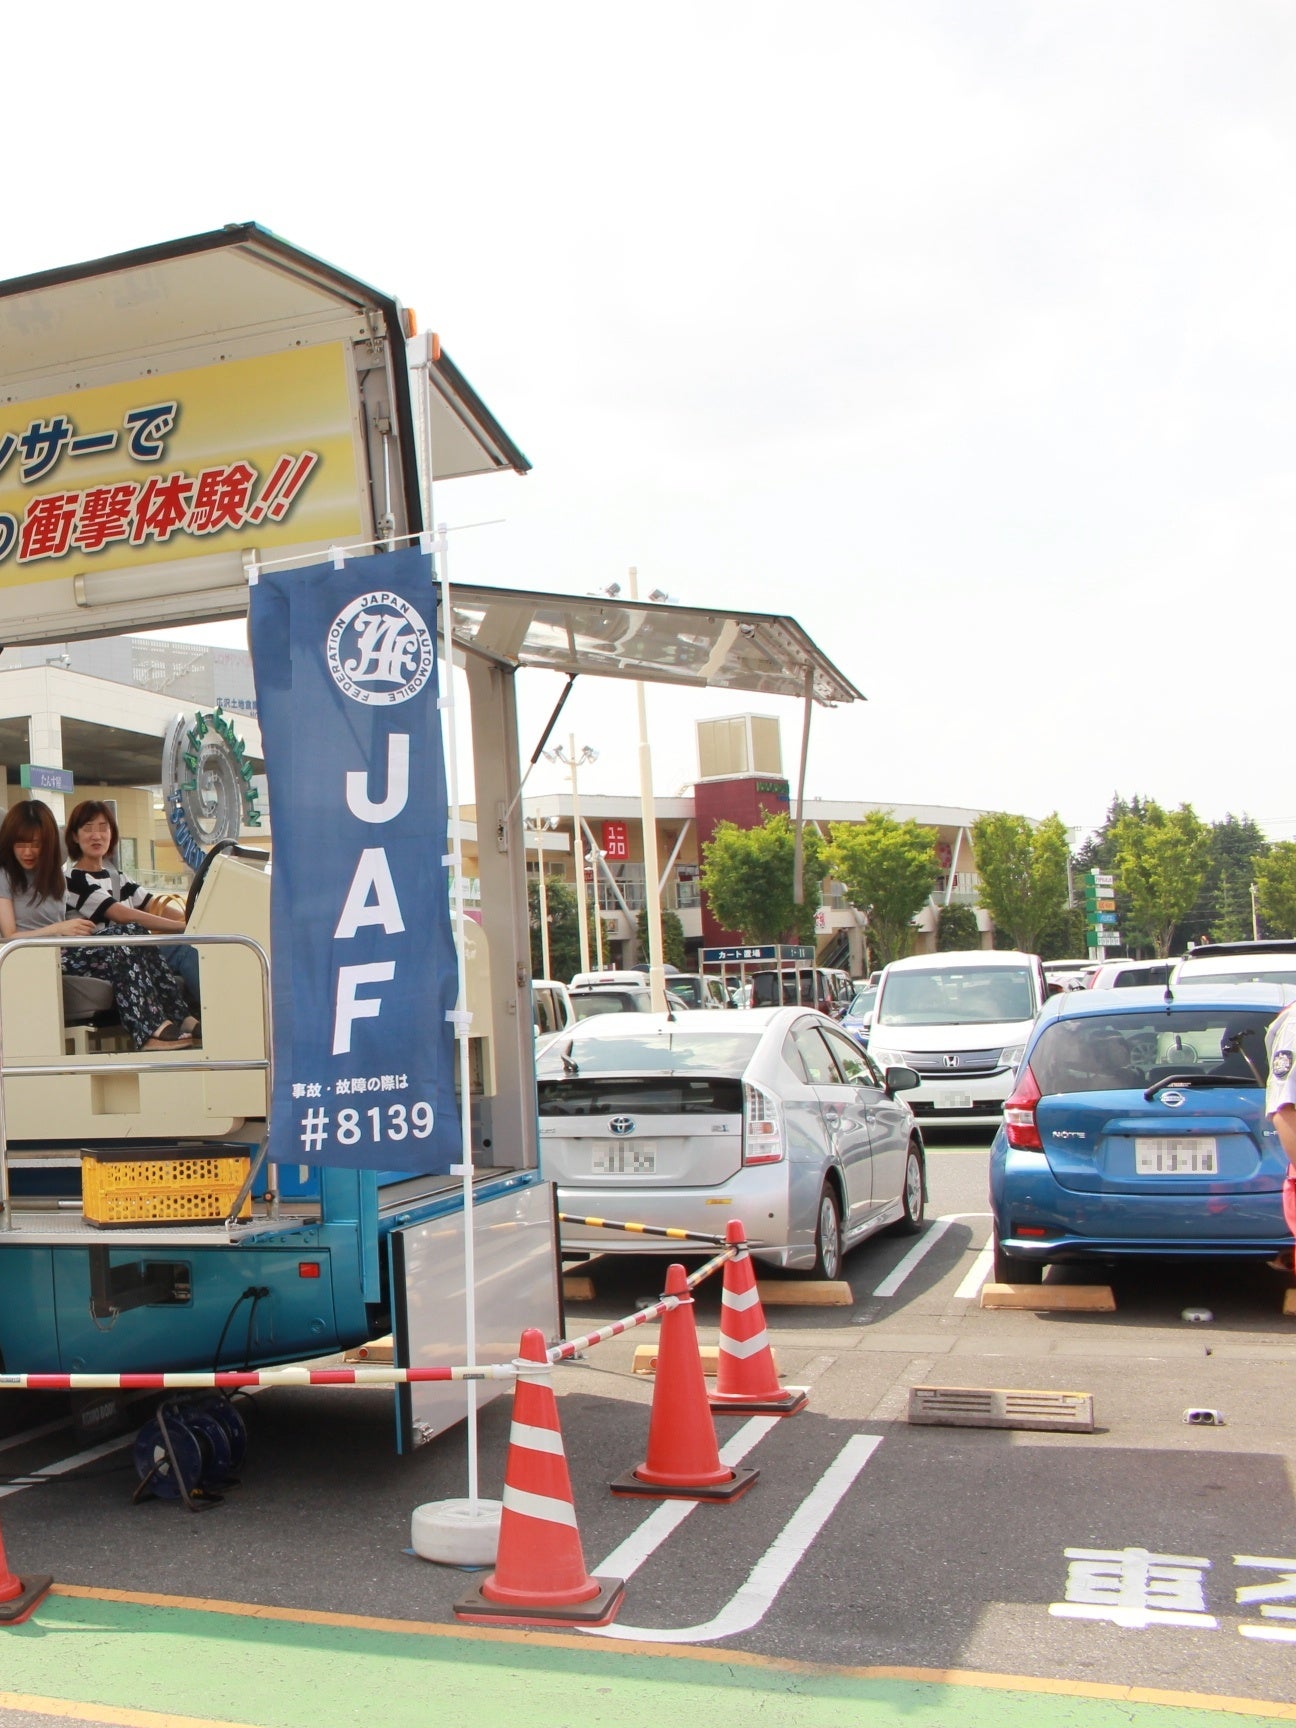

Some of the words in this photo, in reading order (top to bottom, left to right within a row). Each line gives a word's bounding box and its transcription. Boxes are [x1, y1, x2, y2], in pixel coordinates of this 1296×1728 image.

[361, 593, 411, 614] JAPAN
[328, 618, 370, 702] FEDERATION
[388, 628, 432, 702] AUTOMOBILE
[333, 733, 410, 1055] JAF
[292, 1074, 409, 1098] 事故・故障の際は
[301, 1101, 435, 1151] #8139
